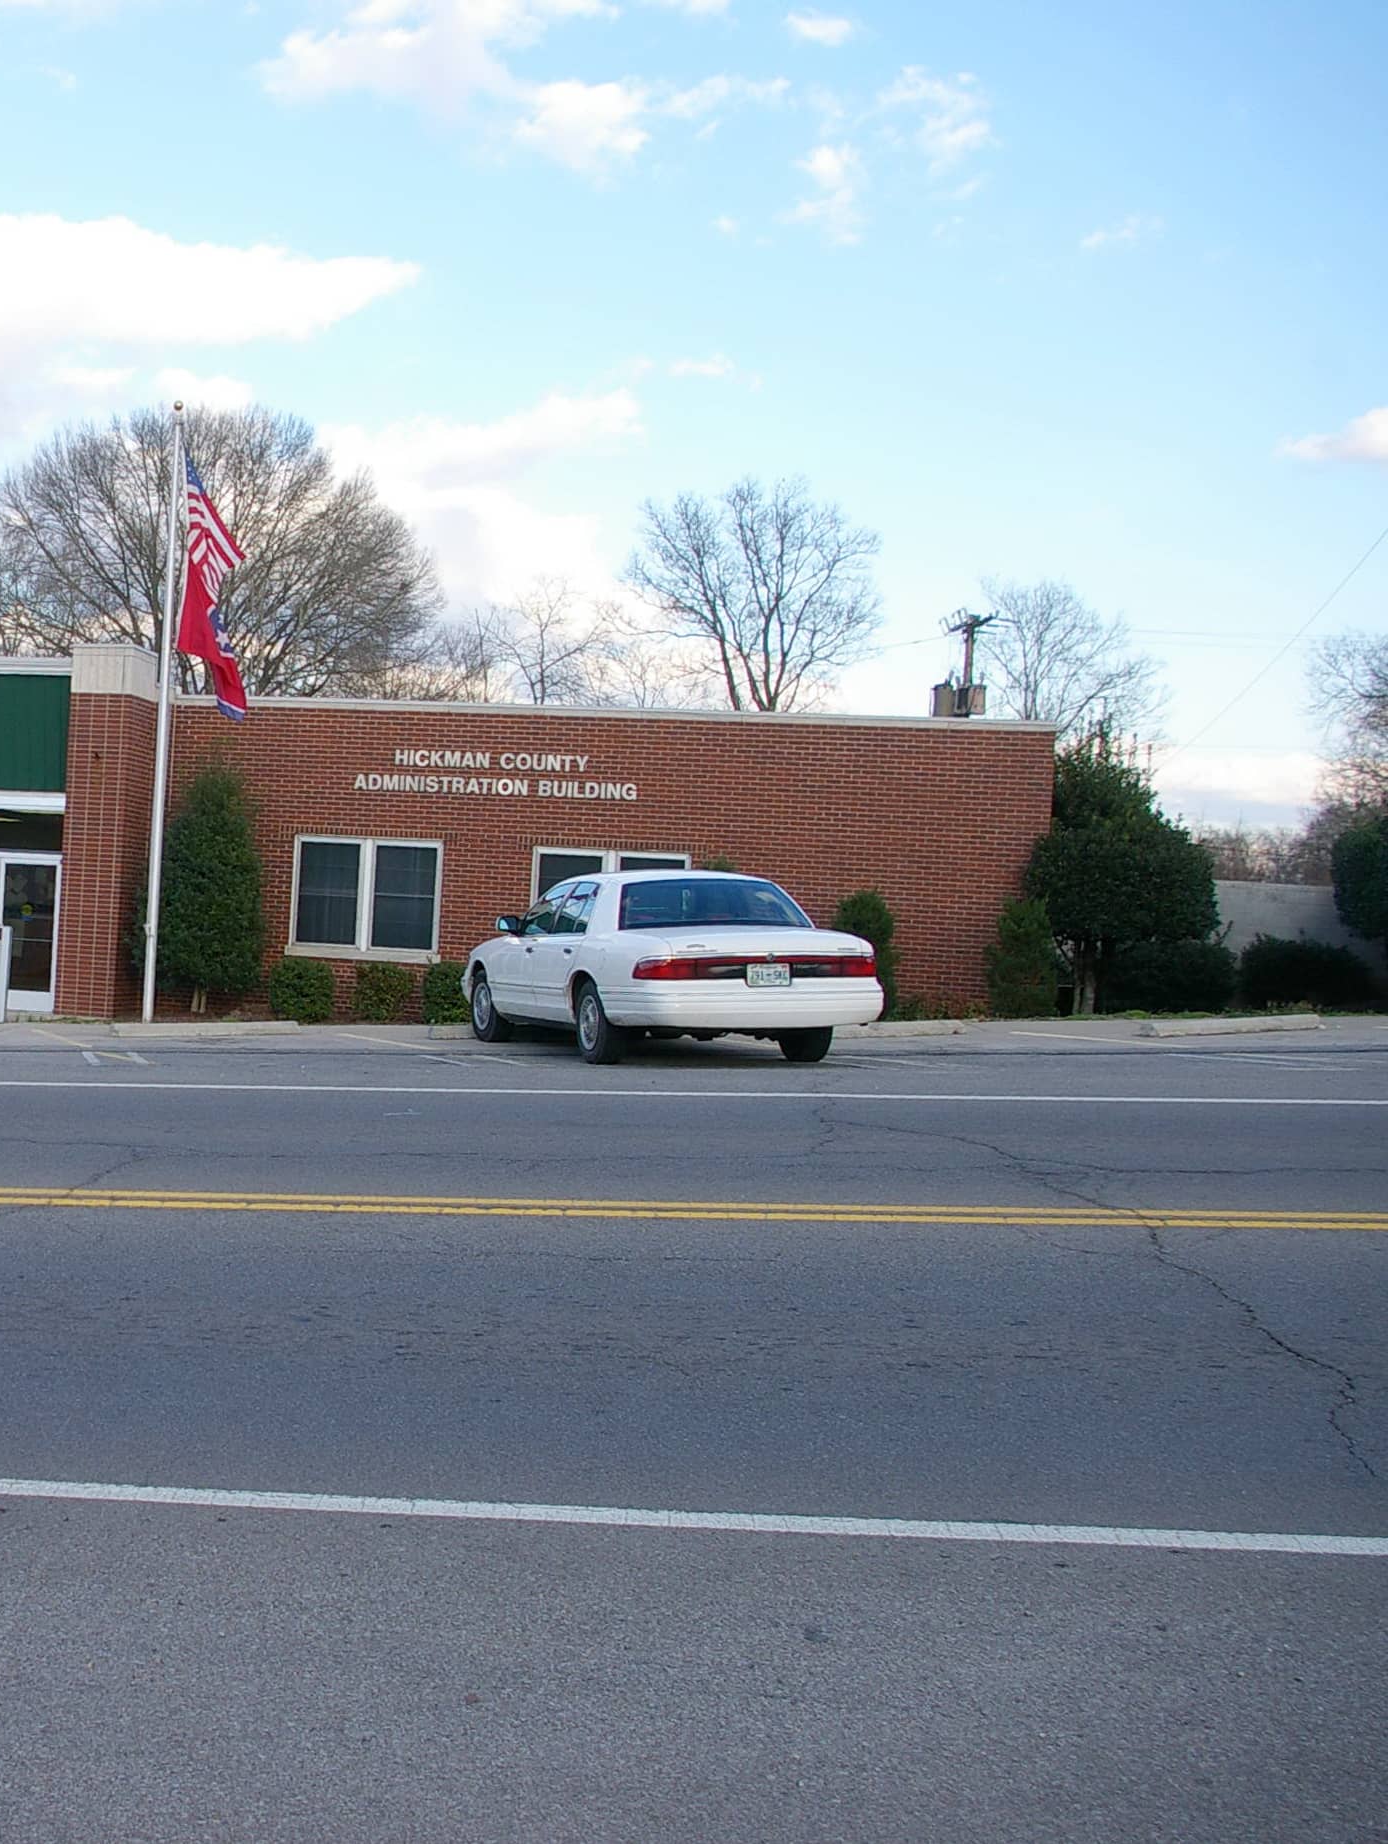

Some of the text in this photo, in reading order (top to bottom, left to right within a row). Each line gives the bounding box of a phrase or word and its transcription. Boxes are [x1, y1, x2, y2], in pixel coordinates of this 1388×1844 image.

[395, 749, 589, 772] HICKMAN COUNTY
[354, 773, 637, 800] ADMINISTRATION BUILDING
